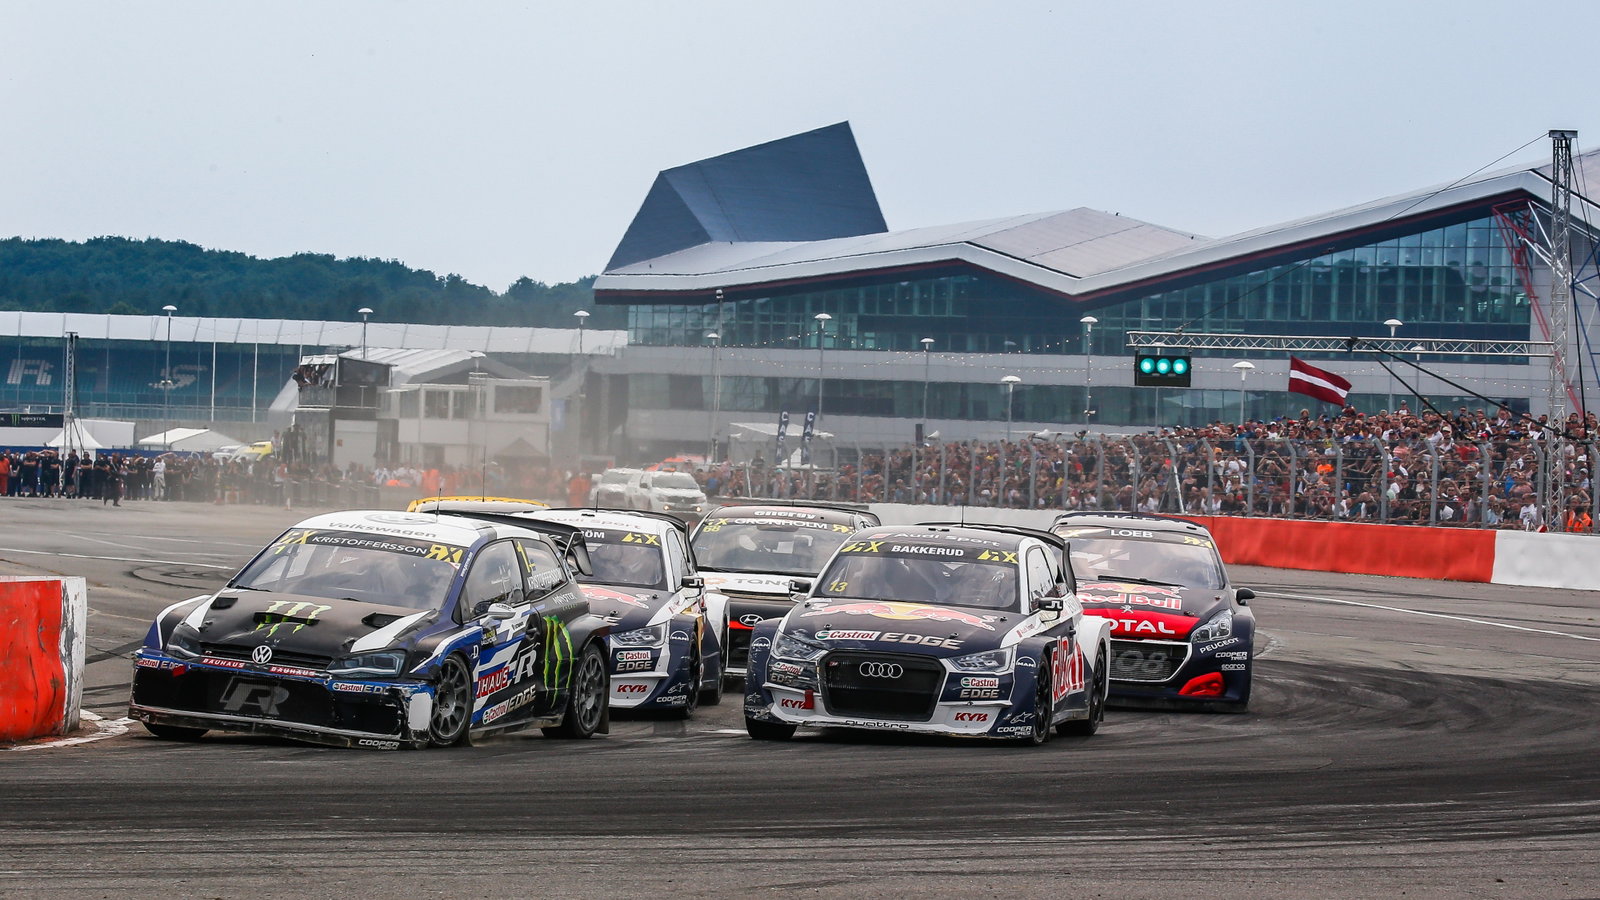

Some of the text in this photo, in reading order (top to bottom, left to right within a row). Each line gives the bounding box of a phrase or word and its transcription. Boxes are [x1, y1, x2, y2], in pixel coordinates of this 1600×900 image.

[328, 521, 437, 538] Volkswagen
[1111, 529, 1154, 538] LOEB
[893, 532, 1001, 547] Audi Sport
[311, 536, 428, 555] KRISTOFFERSSON
[891, 545, 964, 557] BAKKERUD
[829, 582, 848, 593] 13
[1129, 594, 1183, 611] Bull
[1109, 618, 1176, 635] OTAL
[829, 631, 965, 650] Castrol EDGE
[1200, 637, 1239, 654] PEUGEOT
[625, 651, 650, 661] Castrol
[202, 657, 317, 678] BAUHAUS BAUHAUS
[616, 660, 653, 672] EDGE
[340, 683, 362, 692] Castrol
[617, 684, 648, 692] KYB
[970, 678, 998, 687] Castrol
[509, 684, 536, 712] EDGE
[656, 695, 687, 703] COOPER
[960, 689, 999, 698] EDGE
[954, 712, 989, 721] KYB
[845, 719, 910, 729] quattro
[358, 739, 400, 748] COOPER
